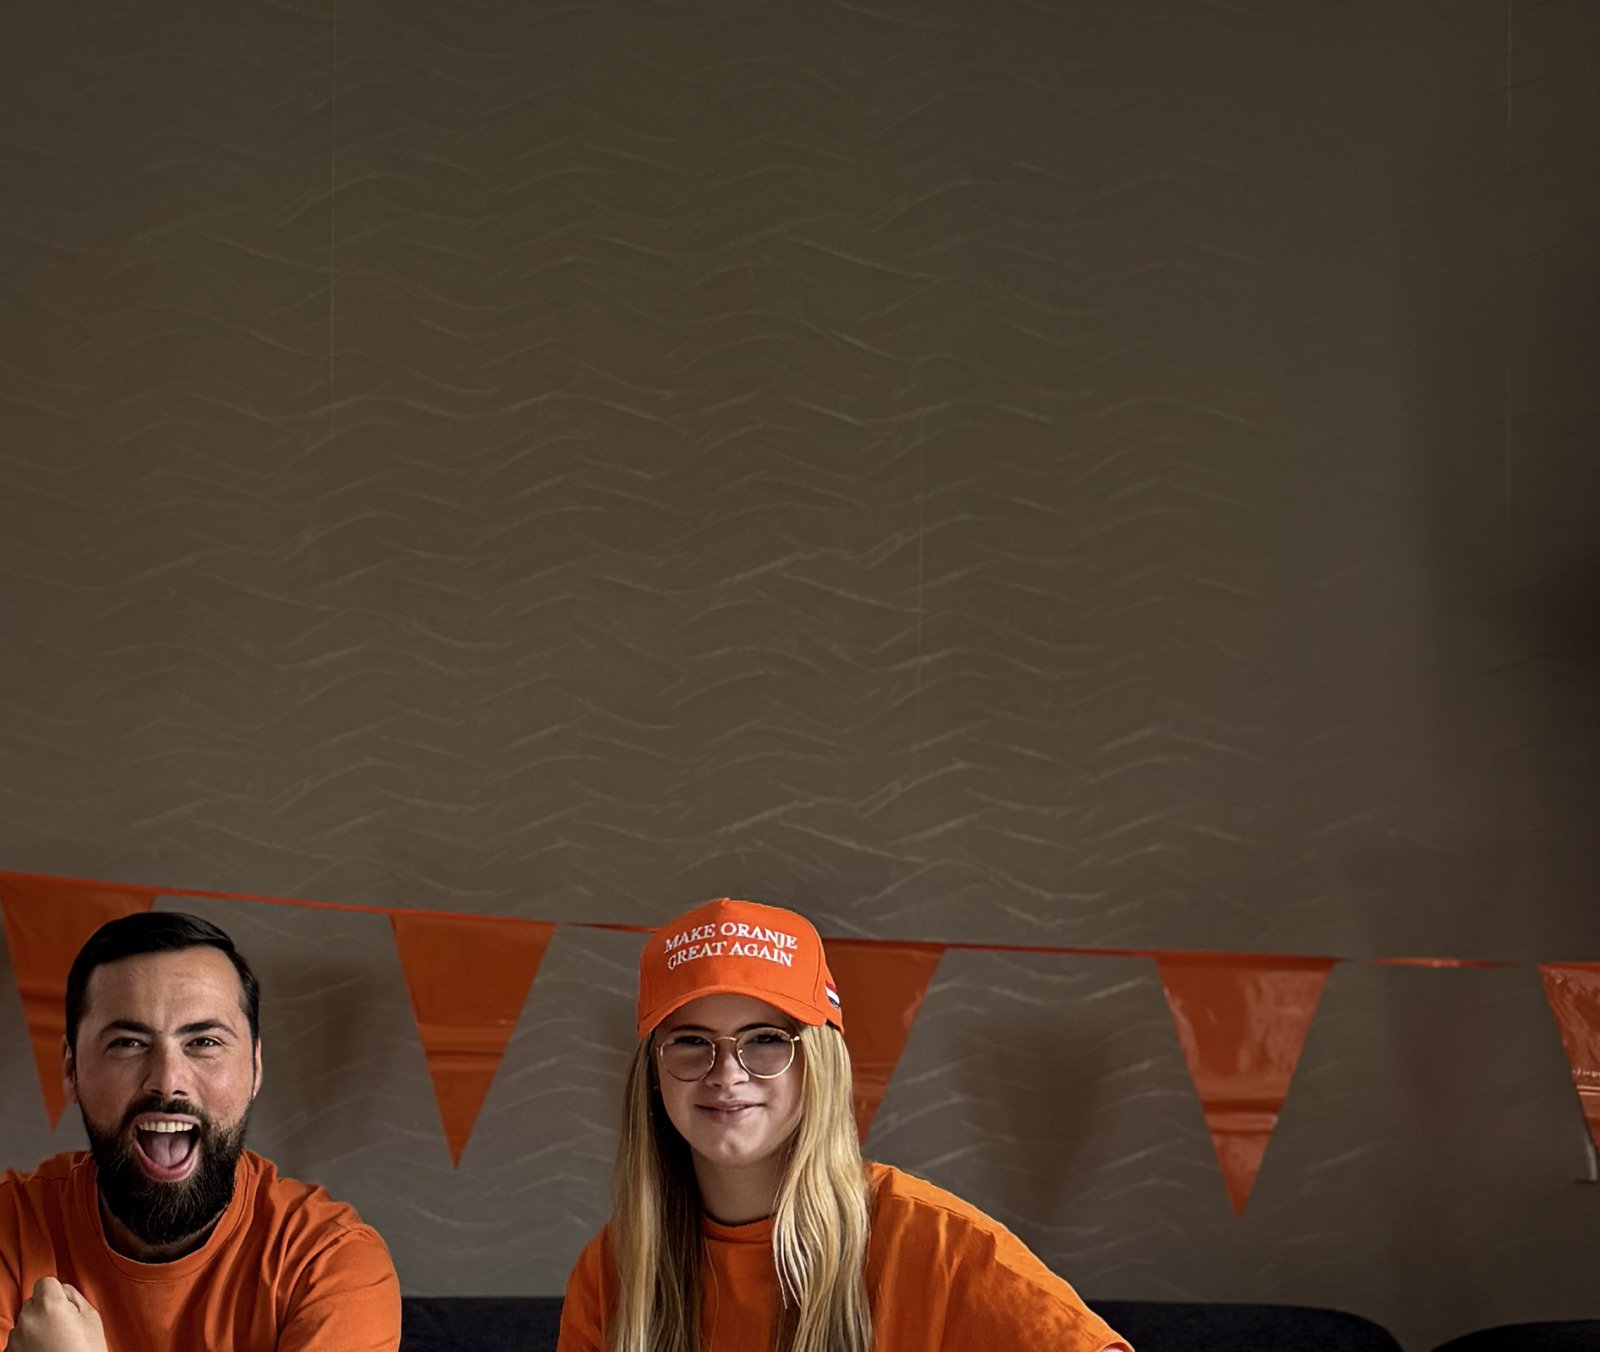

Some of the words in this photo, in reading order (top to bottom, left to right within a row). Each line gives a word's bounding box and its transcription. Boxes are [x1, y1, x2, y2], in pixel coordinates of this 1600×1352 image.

[664, 923, 716, 954] MAKE
[720, 922, 798, 950] ORANJE
[667, 941, 728, 970] GREAT
[728, 941, 793, 968] AGAIN
